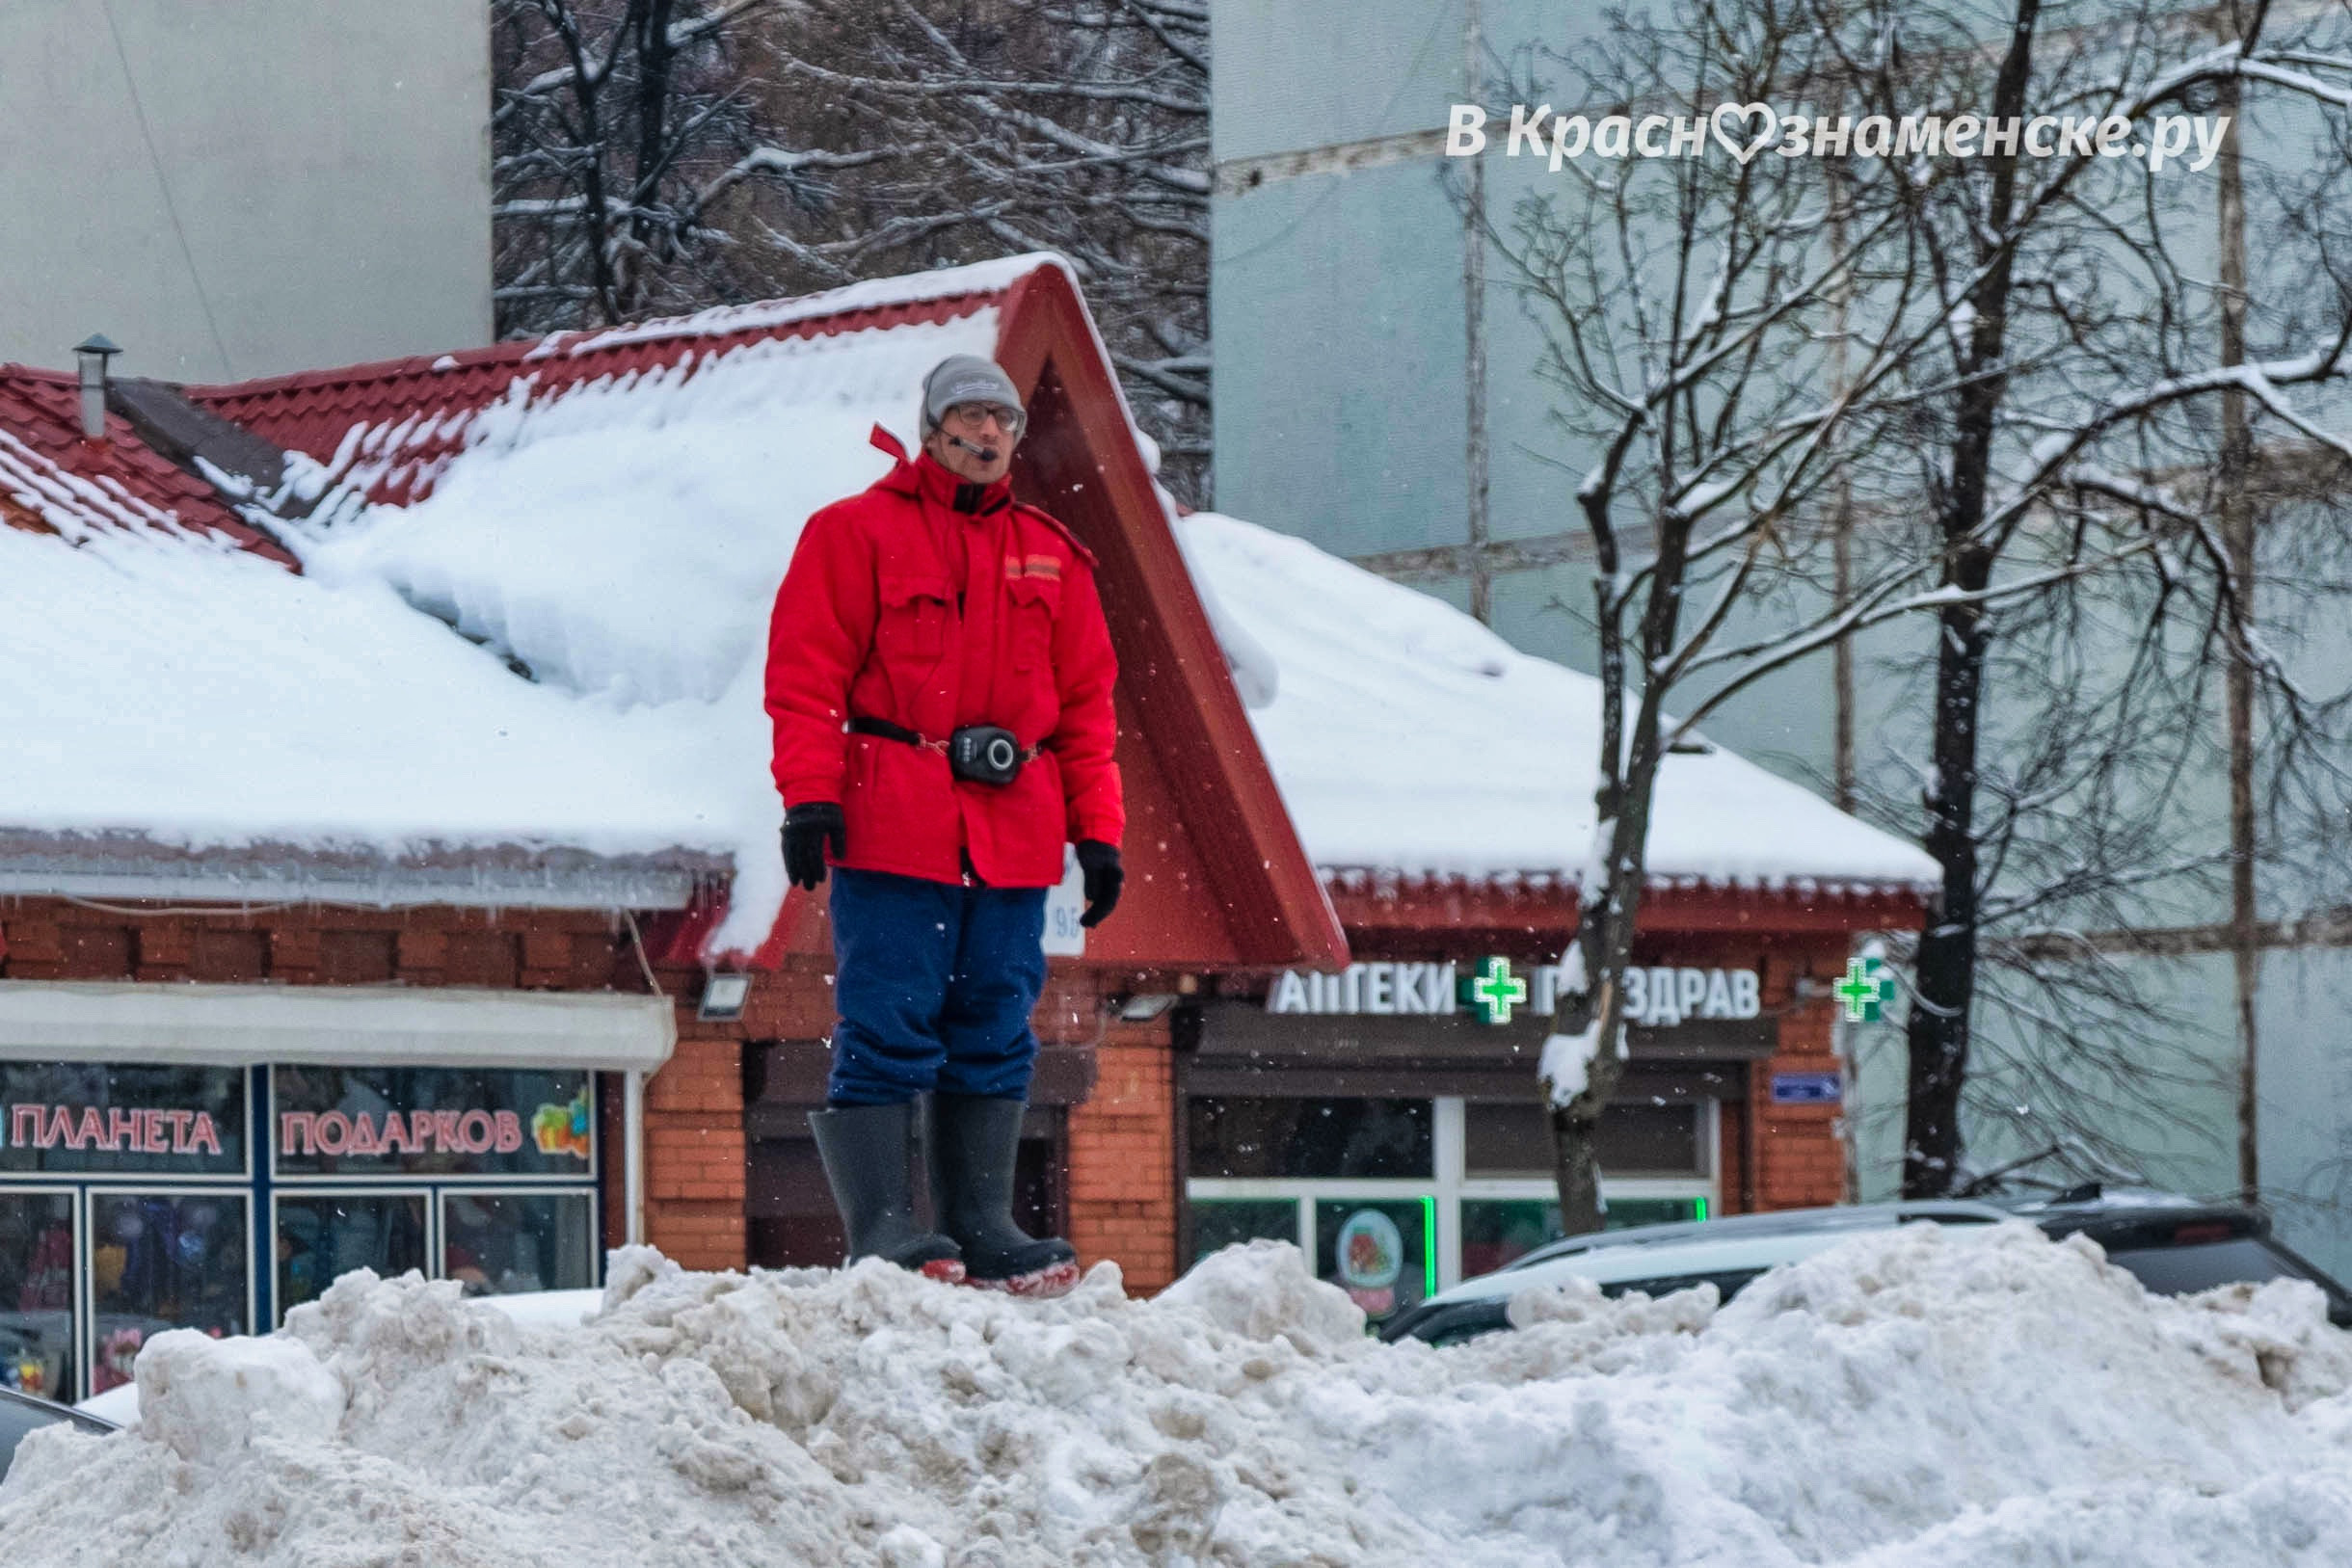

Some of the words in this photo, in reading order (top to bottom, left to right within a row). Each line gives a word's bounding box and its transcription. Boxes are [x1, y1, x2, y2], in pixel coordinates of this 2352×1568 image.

[1532, 964, 1760, 1027] ГЗДРАВ
[11, 1103, 222, 1155] ПЛАНЕТА
[281, 1109, 523, 1156] ПОДАРКОВ
